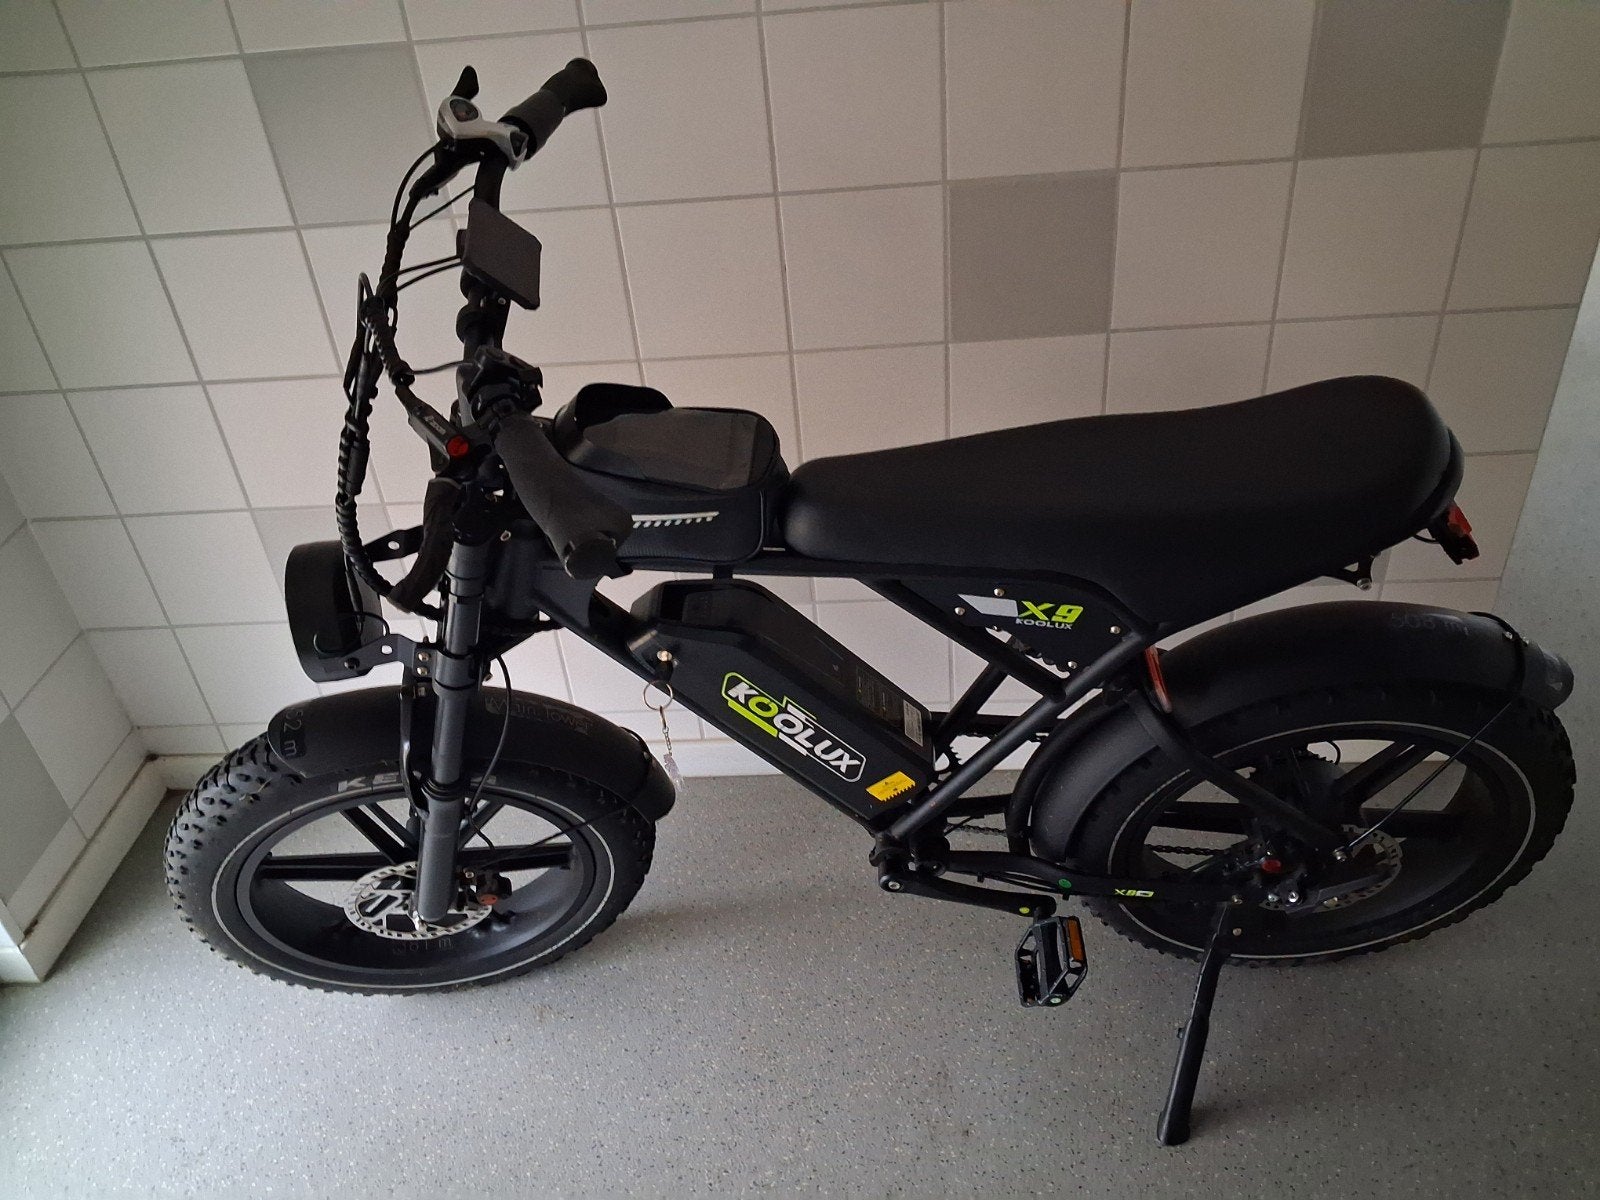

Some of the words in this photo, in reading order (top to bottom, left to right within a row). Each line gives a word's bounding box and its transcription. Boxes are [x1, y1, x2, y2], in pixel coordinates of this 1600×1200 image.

[1019, 600, 1085, 623] X9
[1015, 617, 1073, 630] KOOLUX
[727, 681, 861, 774] KOOLUX
